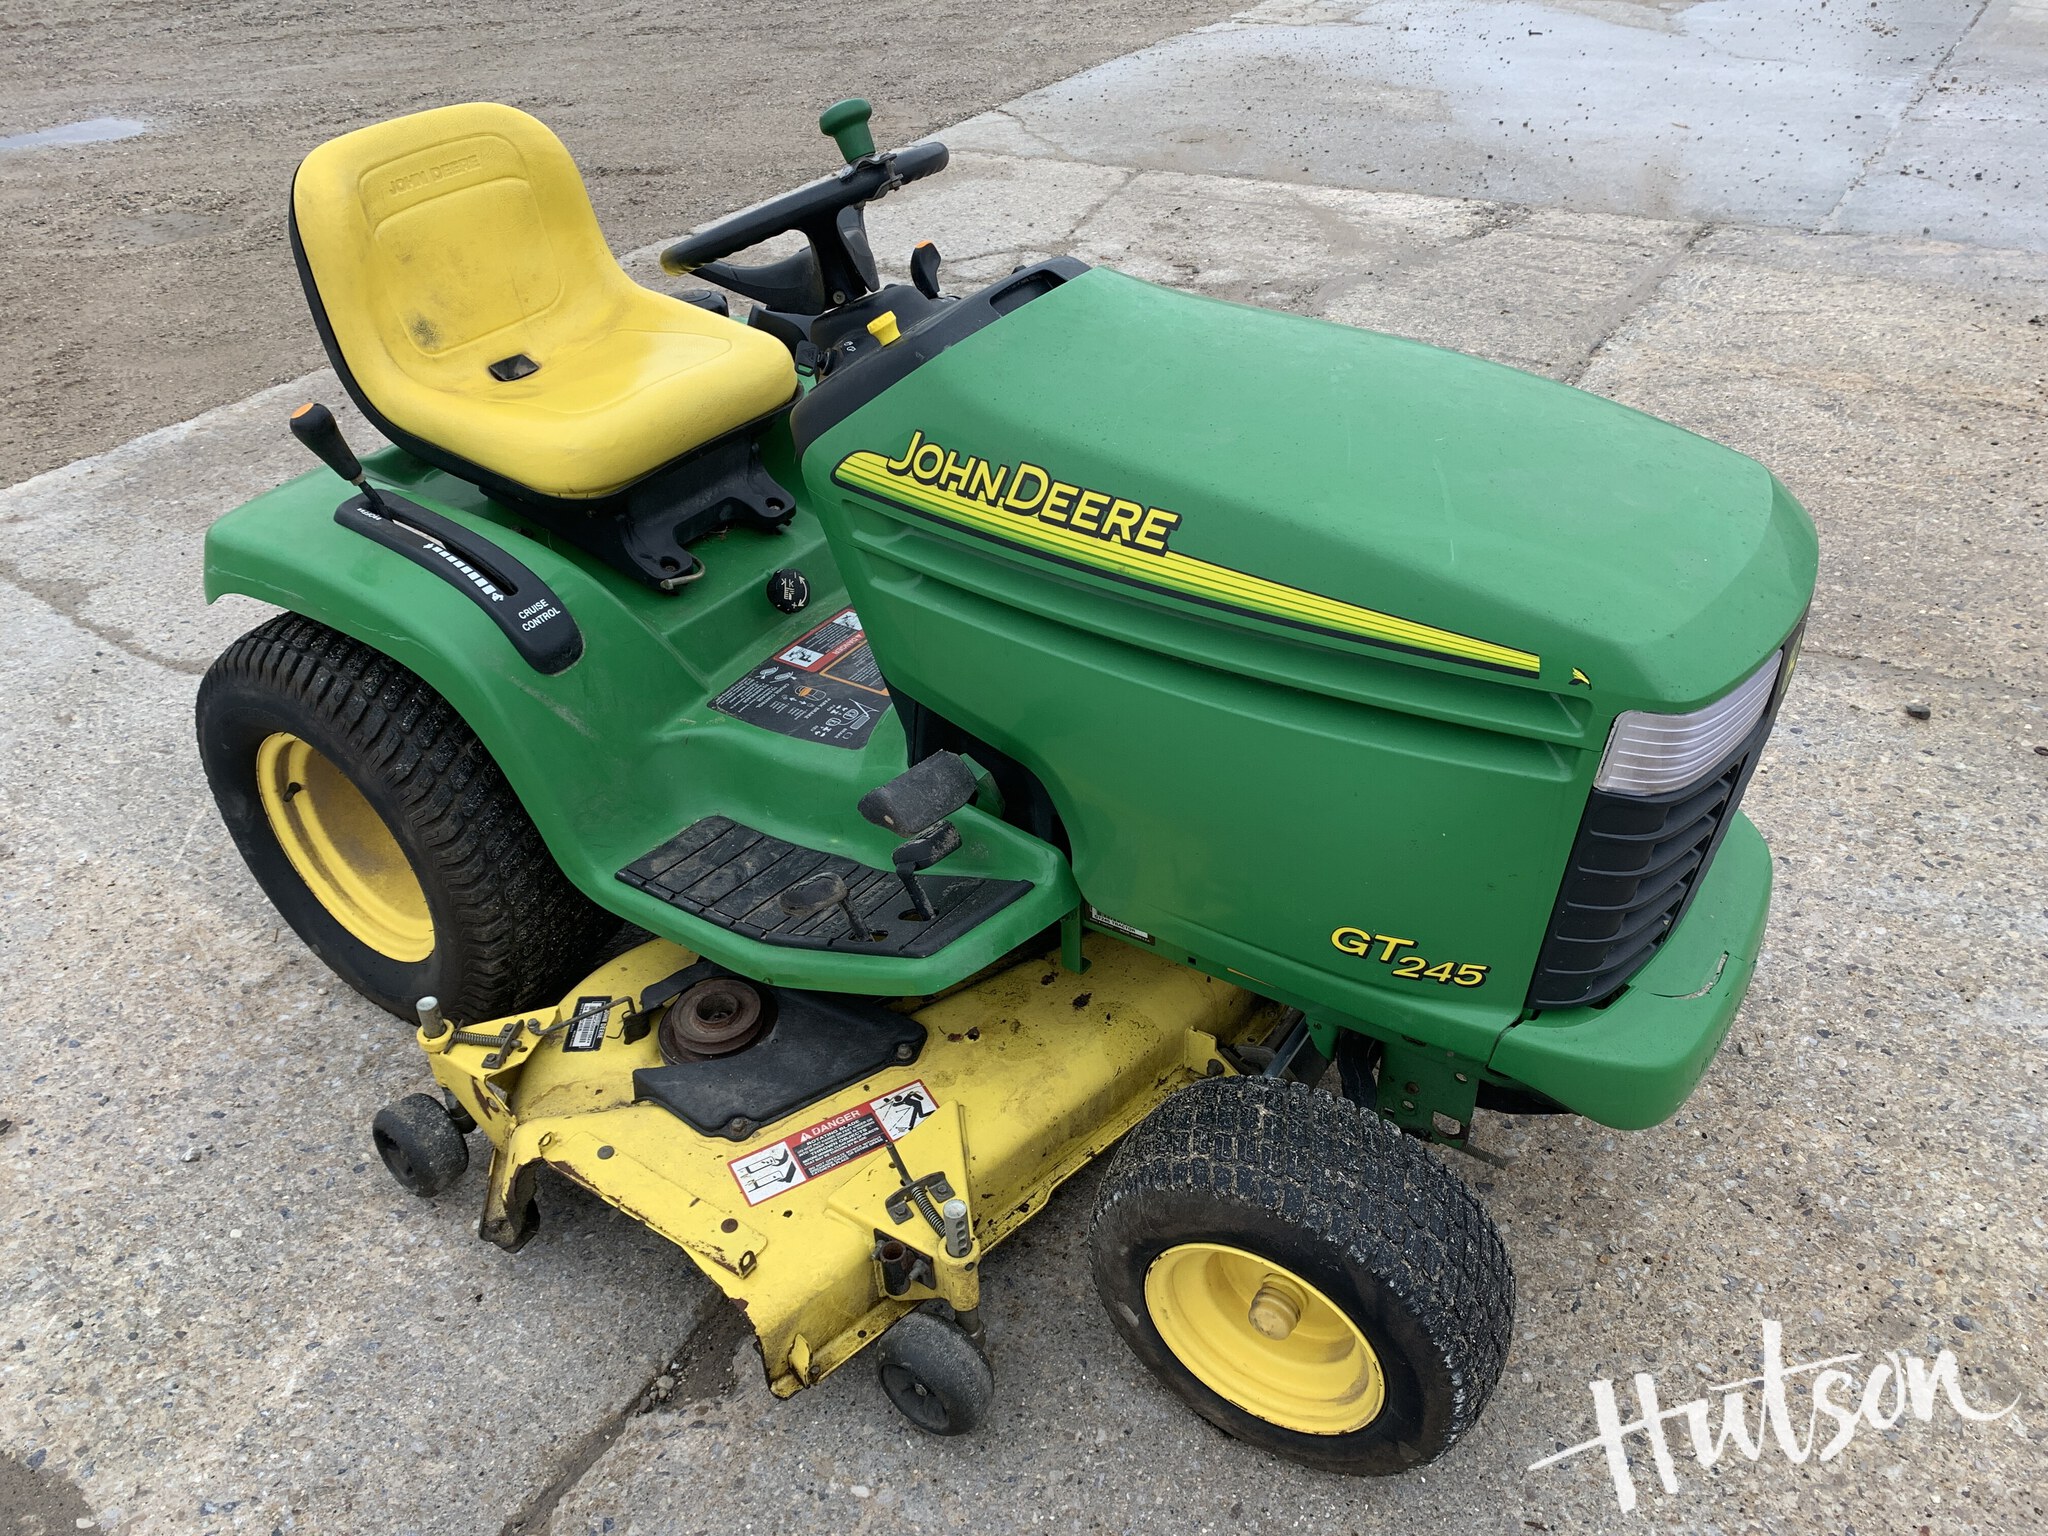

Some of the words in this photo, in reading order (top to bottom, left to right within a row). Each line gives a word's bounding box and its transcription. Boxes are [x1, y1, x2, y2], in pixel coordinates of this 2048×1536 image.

[389, 170, 429, 196] JOHN
[430, 154, 481, 182] DEERE
[887, 430, 1009, 505] JOHN
[1004, 462, 1181, 554] DEERE
[518, 598, 549, 620] CRUISE
[521, 607, 561, 632] CONTROL
[832, 636, 857, 655] DANGER
[806, 1130, 838, 1146] ROTATING
[839, 1119, 859, 1130] BLADE
[811, 1110, 860, 1135] DANGER
[810, 1141, 838, 1156] THROWN
[838, 1127, 867, 1143] OBJECTS
